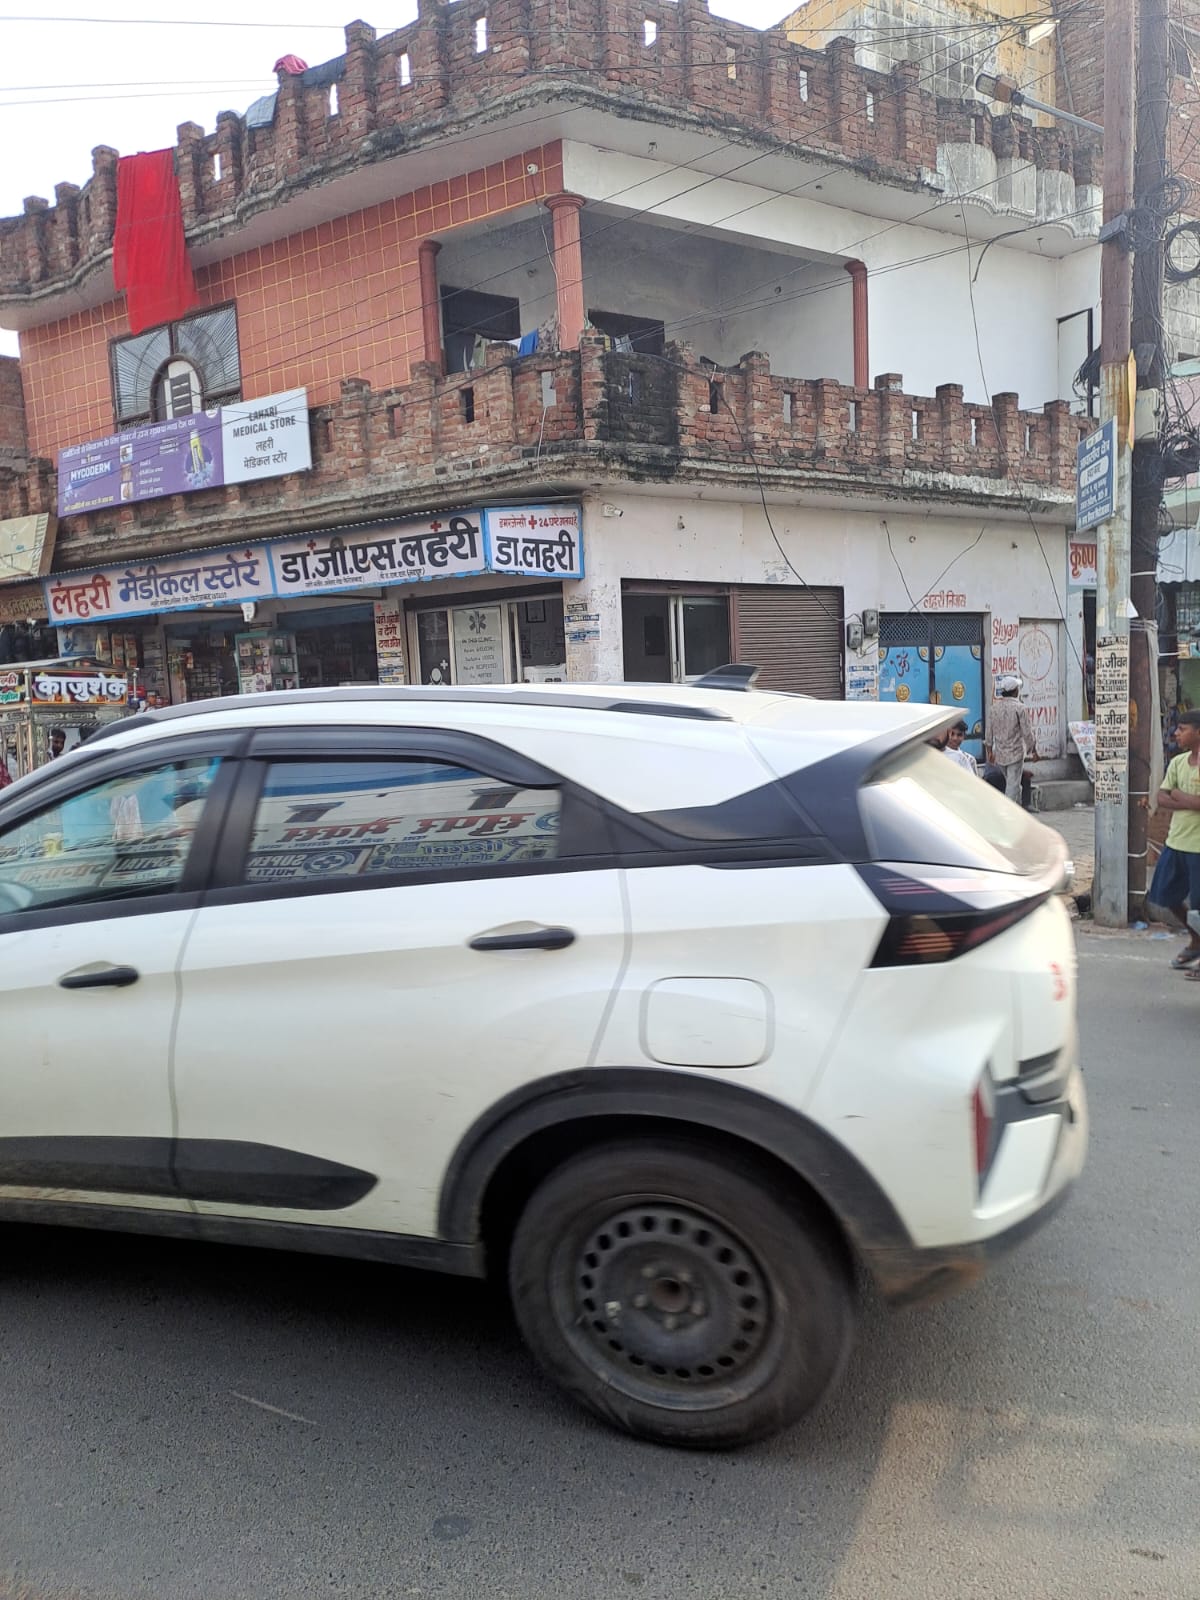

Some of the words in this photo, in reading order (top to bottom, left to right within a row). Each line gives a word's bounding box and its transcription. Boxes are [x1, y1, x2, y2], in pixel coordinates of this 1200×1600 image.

[249, 405, 278, 421] LAHARI
[233, 422, 268, 438] MEDICAL
[270, 415, 296, 430] STORE
[255, 436, 274, 451] लहरी
[243, 455, 270, 468] मेडिकल
[271, 450, 288, 463] स्टोर
[70, 460, 111, 481] MYCODERM
[50, 575, 111, 617] लहरी
